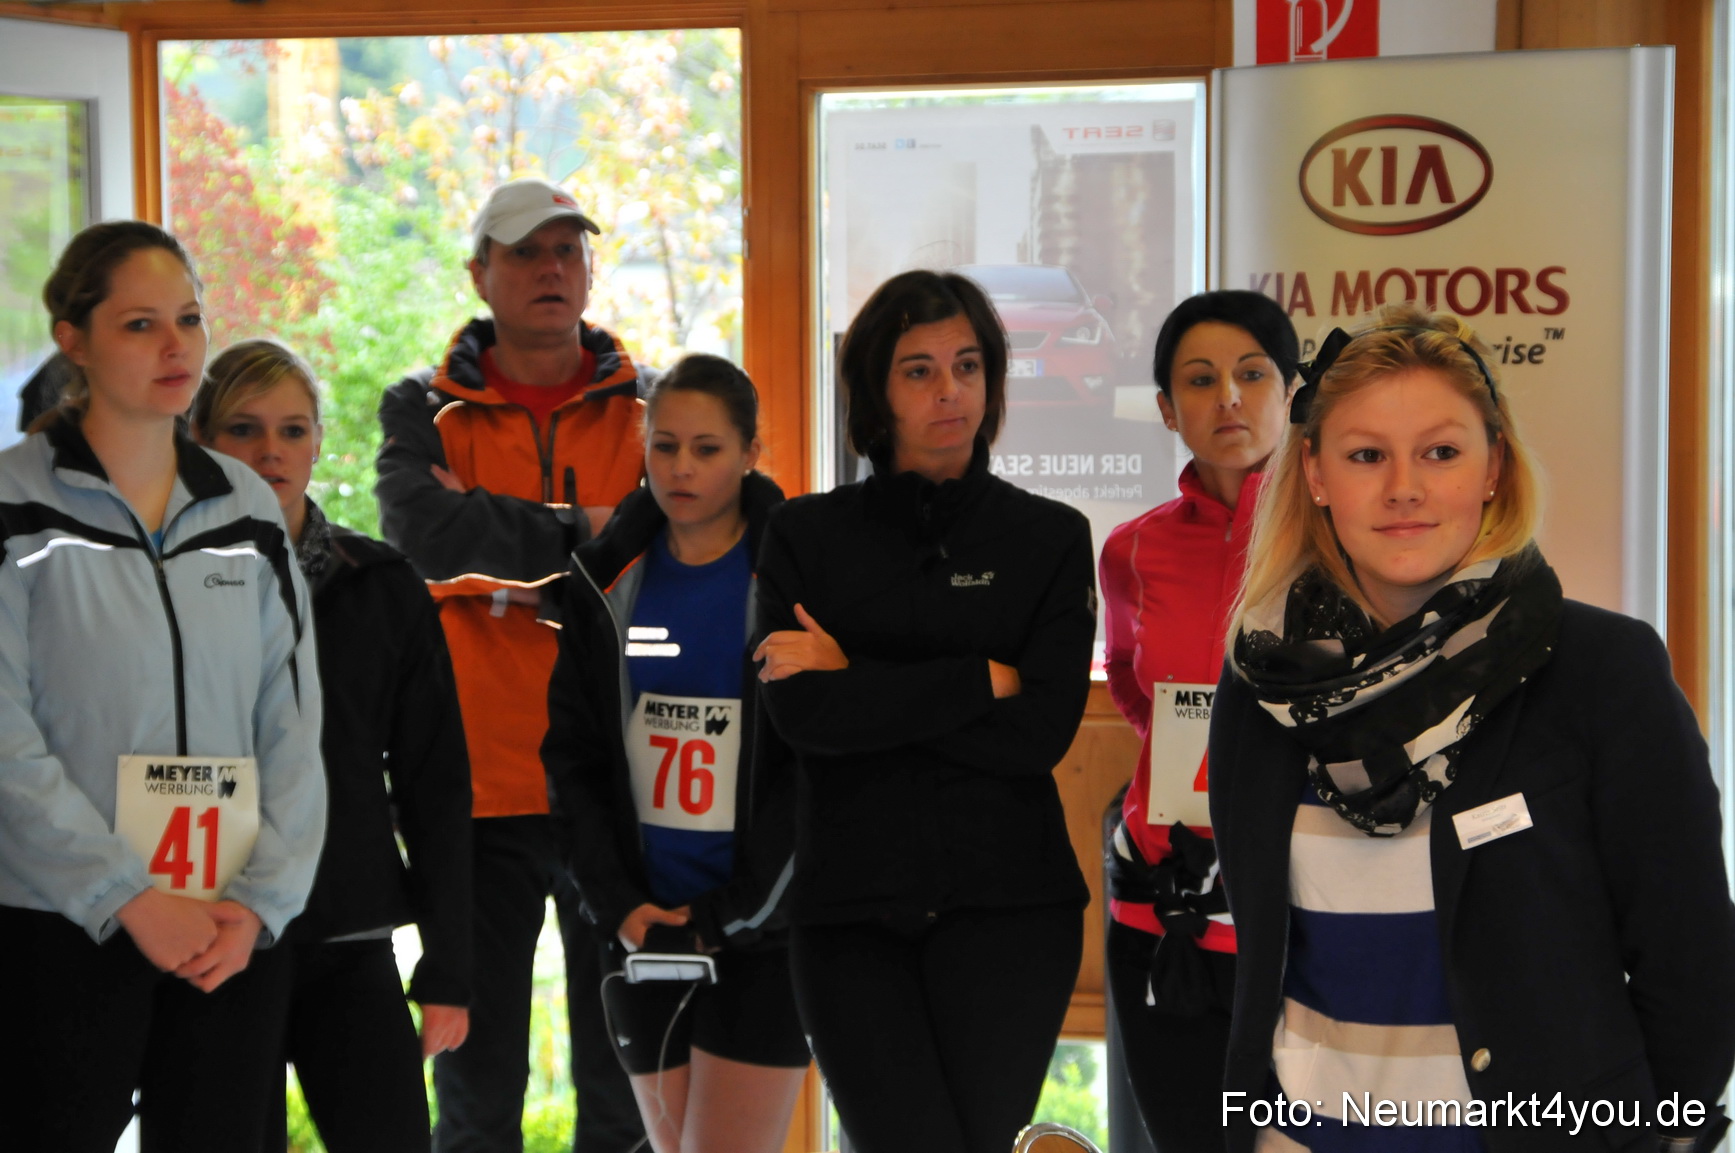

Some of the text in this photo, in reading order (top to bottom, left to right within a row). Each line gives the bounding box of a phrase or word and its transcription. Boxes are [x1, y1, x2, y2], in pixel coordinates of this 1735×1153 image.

[1331, 144, 1456, 207] KIA
[1330, 265, 1571, 317] MOTORS
[644, 700, 700, 719] MEYER
[644, 716, 700, 732] WERBUNG
[144, 764, 213, 782] MEYER
[144, 782, 214, 796] WERBUNG
[649, 734, 716, 816] 76
[148, 806, 219, 890] 41
